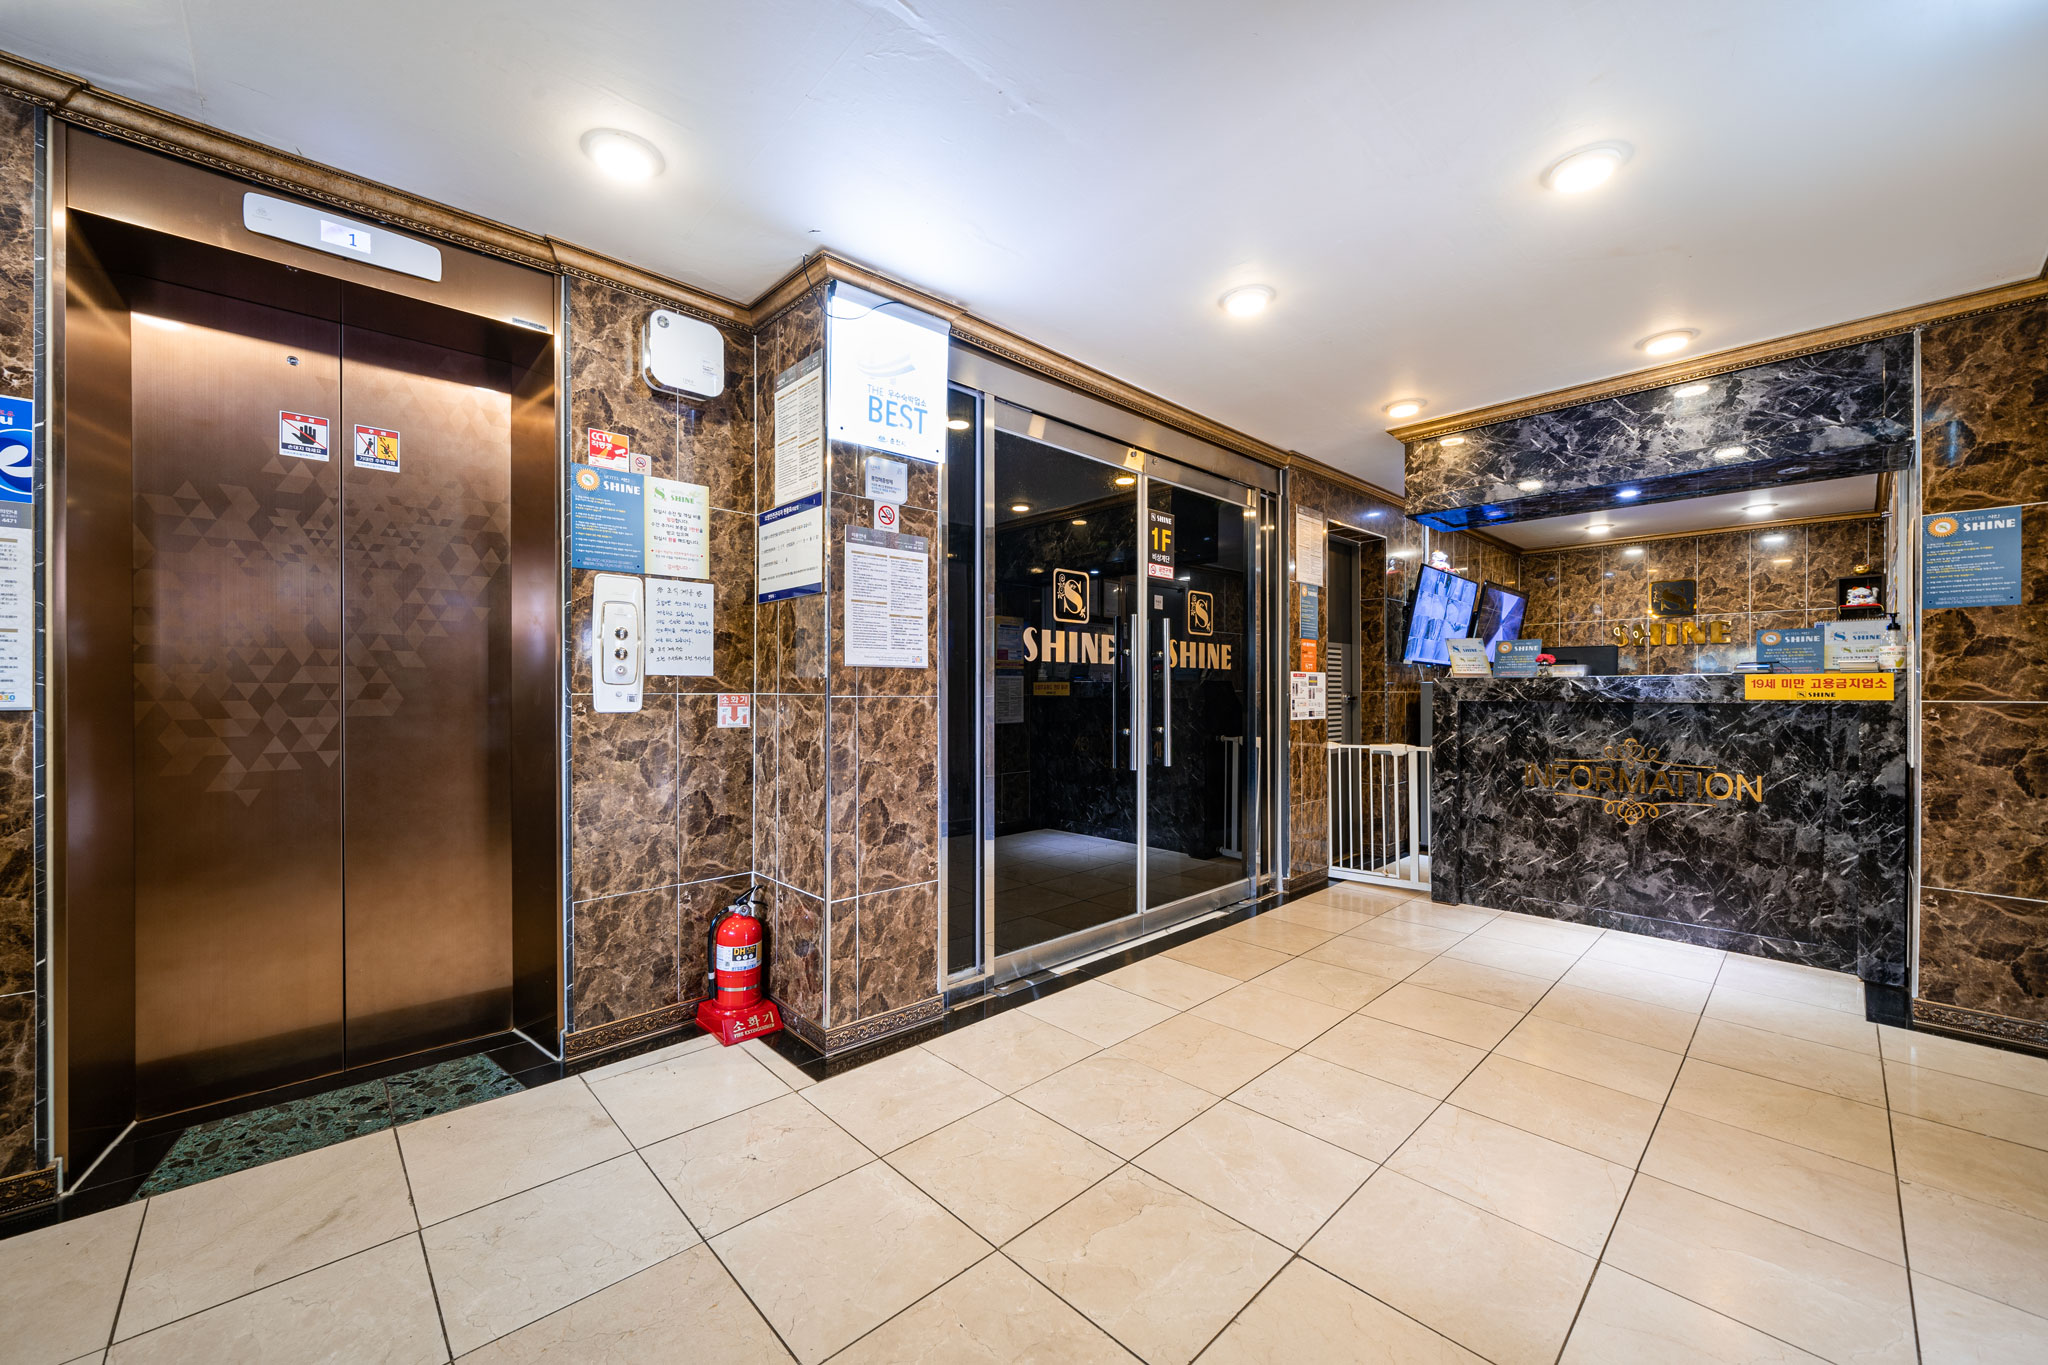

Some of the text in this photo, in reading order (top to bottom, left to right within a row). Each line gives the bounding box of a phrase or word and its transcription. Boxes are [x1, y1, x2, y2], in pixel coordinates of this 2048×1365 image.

[348, 234, 357, 247] 1
[867, 383, 927, 408] THE 우수숙박업소
[868, 395, 928, 435] BEST
[591, 432, 613, 443] CCTV
[603, 480, 641, 496] SHINE
[670, 494, 694, 504] SHINE
[1156, 514, 1172, 526] SHINE
[1963, 518, 2016, 532] SHINE
[1151, 527, 1172, 552] 1F
[1152, 553, 1170, 564] 비상계단
[1614, 620, 1732, 648] SHINE
[1022, 626, 1115, 664] SHINE
[1170, 638, 1232, 670] SHINE
[1752, 678, 1888, 689] 19세 미만 고용금지업소
[721, 695, 748, 705] 소화기
[1524, 763, 1762, 802] INFORMATION
[734, 948, 746, 956] DH
[733, 1010, 775, 1033] 소화기
